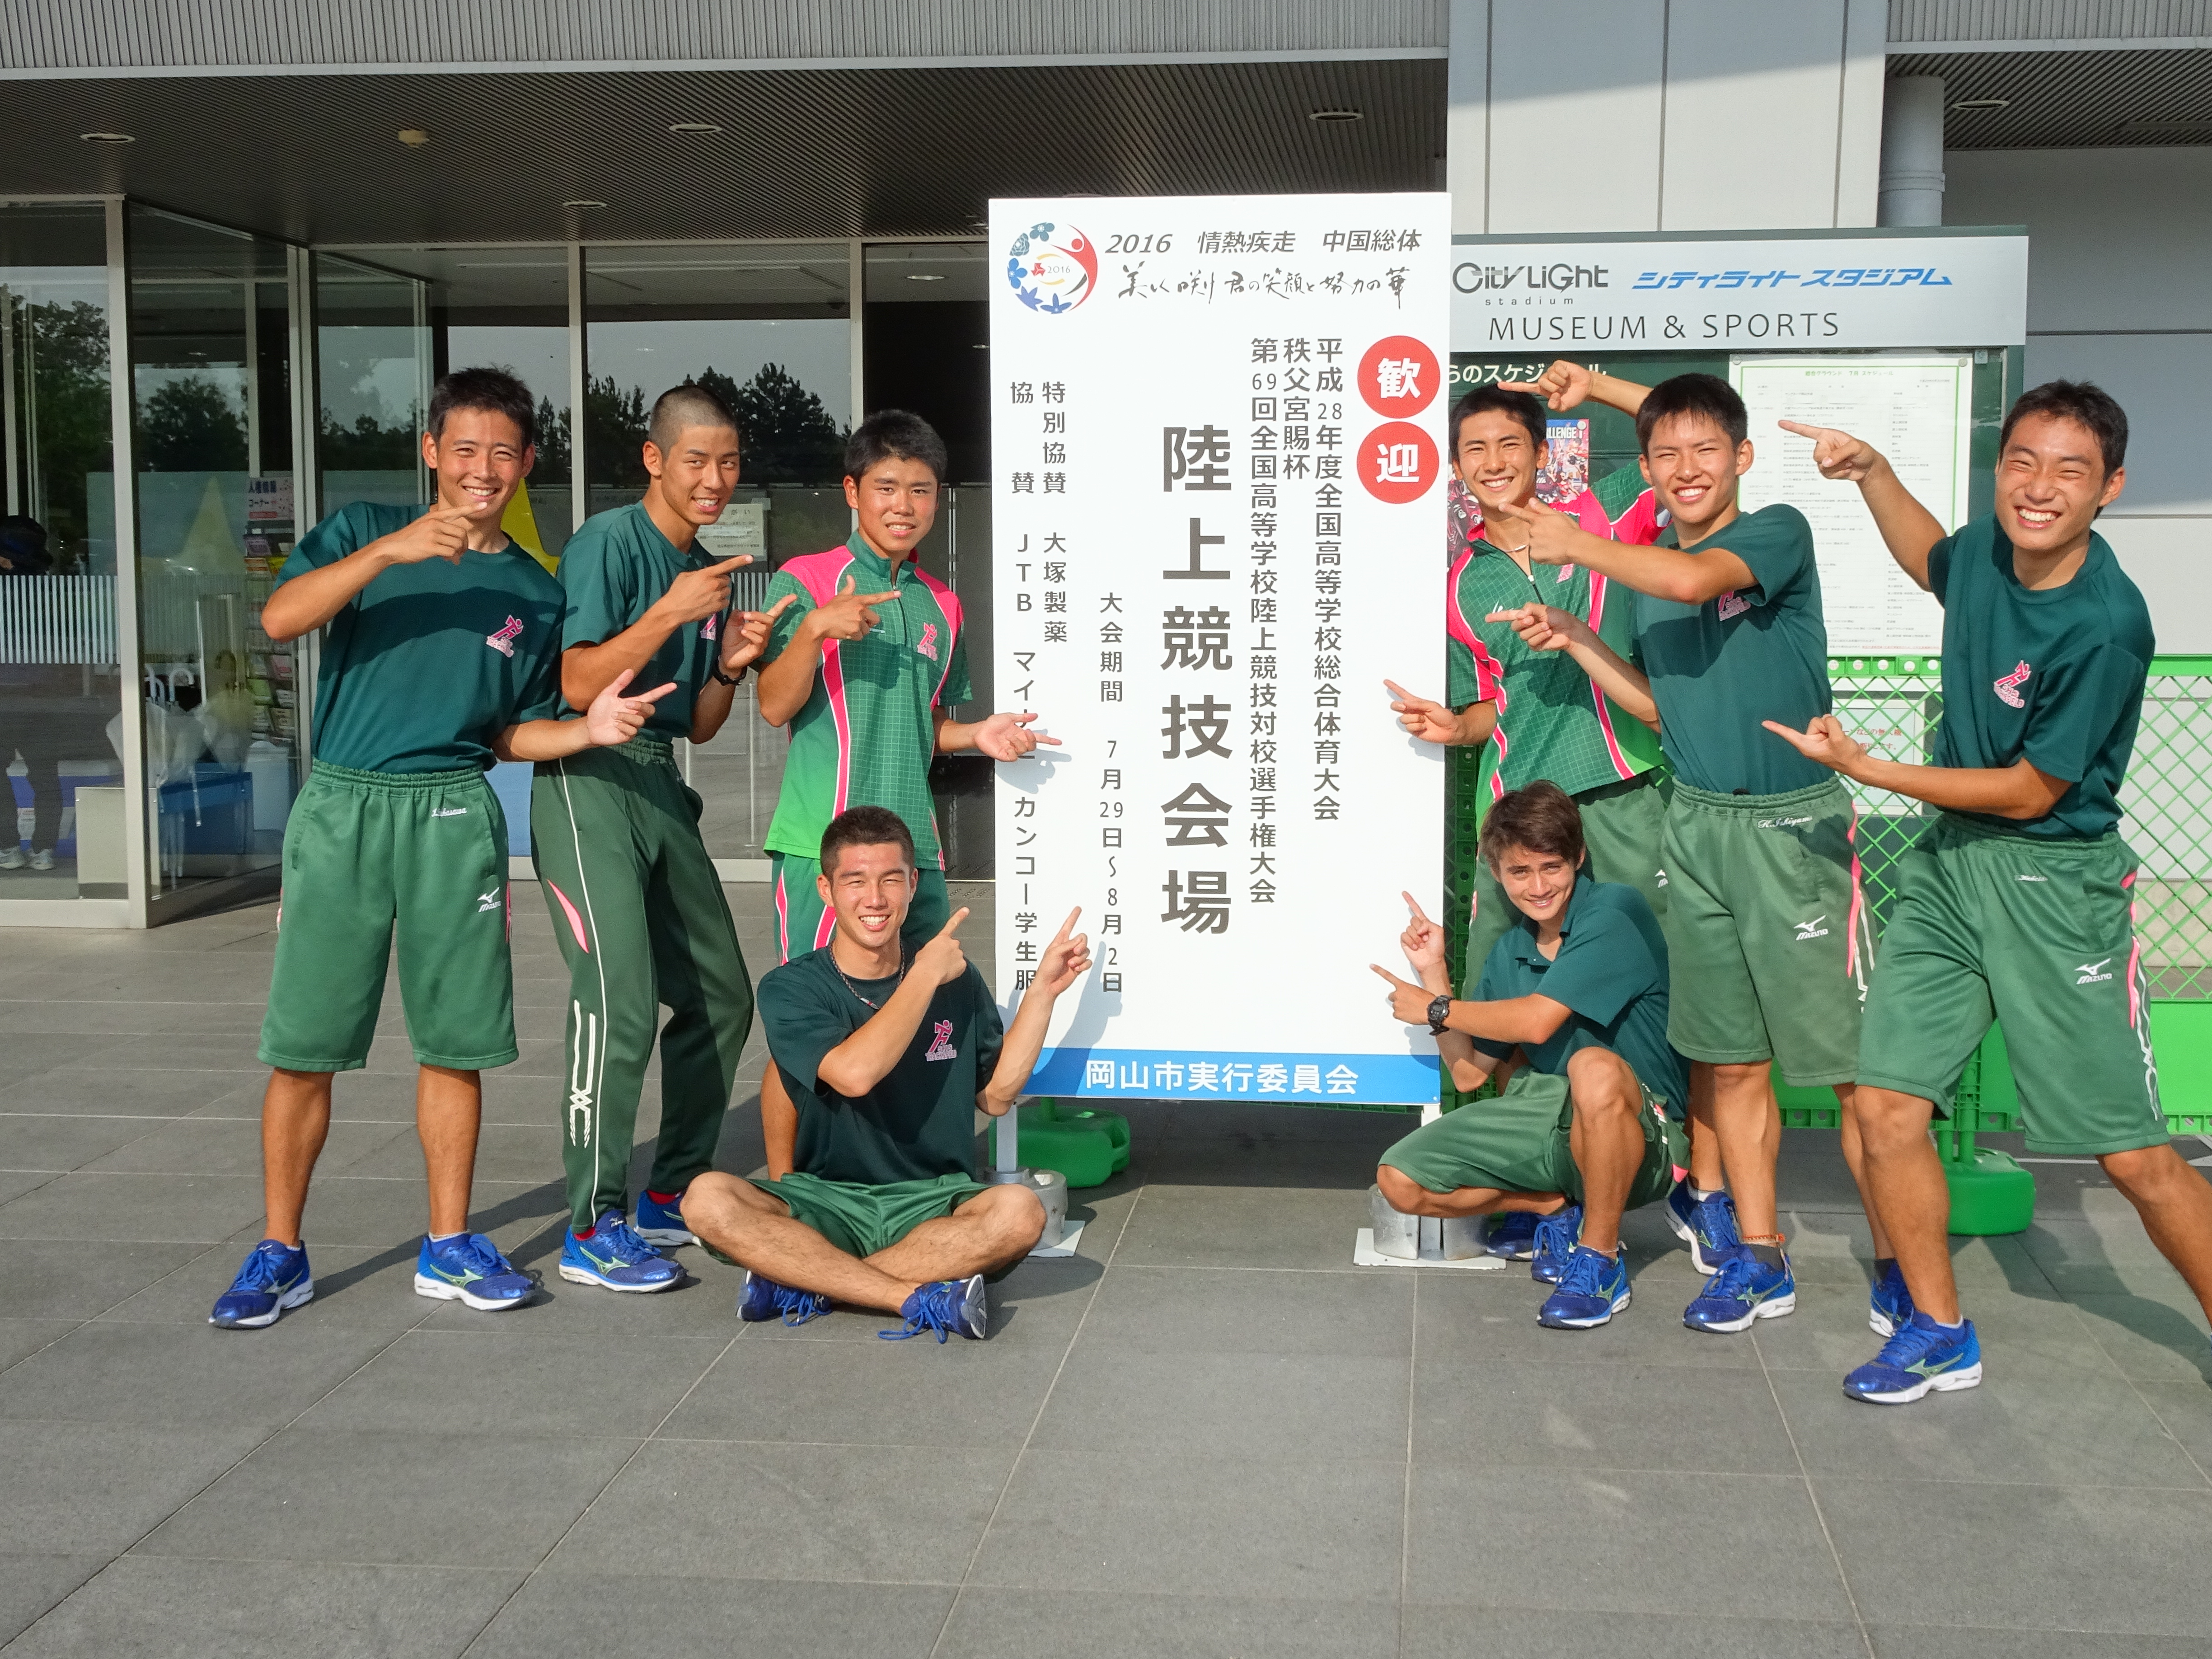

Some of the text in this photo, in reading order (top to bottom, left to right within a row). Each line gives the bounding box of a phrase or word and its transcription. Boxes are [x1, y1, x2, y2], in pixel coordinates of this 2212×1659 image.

[1047, 265, 1071, 274] 2016
[1105, 229, 1422, 254] 2016 情熱疾走 中国総体
[1485, 296, 1574, 305] stadium
[1631, 268, 1953, 290] シティライト スタジアム
[1489, 312, 1839, 341] MUSEUM & SPORTS
[1282, 337, 1311, 480] 秩父宮賜杯
[1376, 357, 1422, 483] 歓迎
[1042, 381, 1067, 643] 特別協賛 大塚製薬
[1016, 534, 1032, 612] JTB
[1313, 338, 1343, 820] 平成28年度全国高等学校総合体育大会
[1100, 592, 1123, 703] 大会期間
[1250, 338, 1278, 903] 第69回全国高等学校陸上競技対校選手権大会
[1160, 425, 1233, 934] 陸上競技会場
[1795, 928, 1829, 941] MIZUNO
[2076, 973, 2113, 984] MIZUNO
[1086, 1060, 1359, 1095] 岡山市実行委員会
